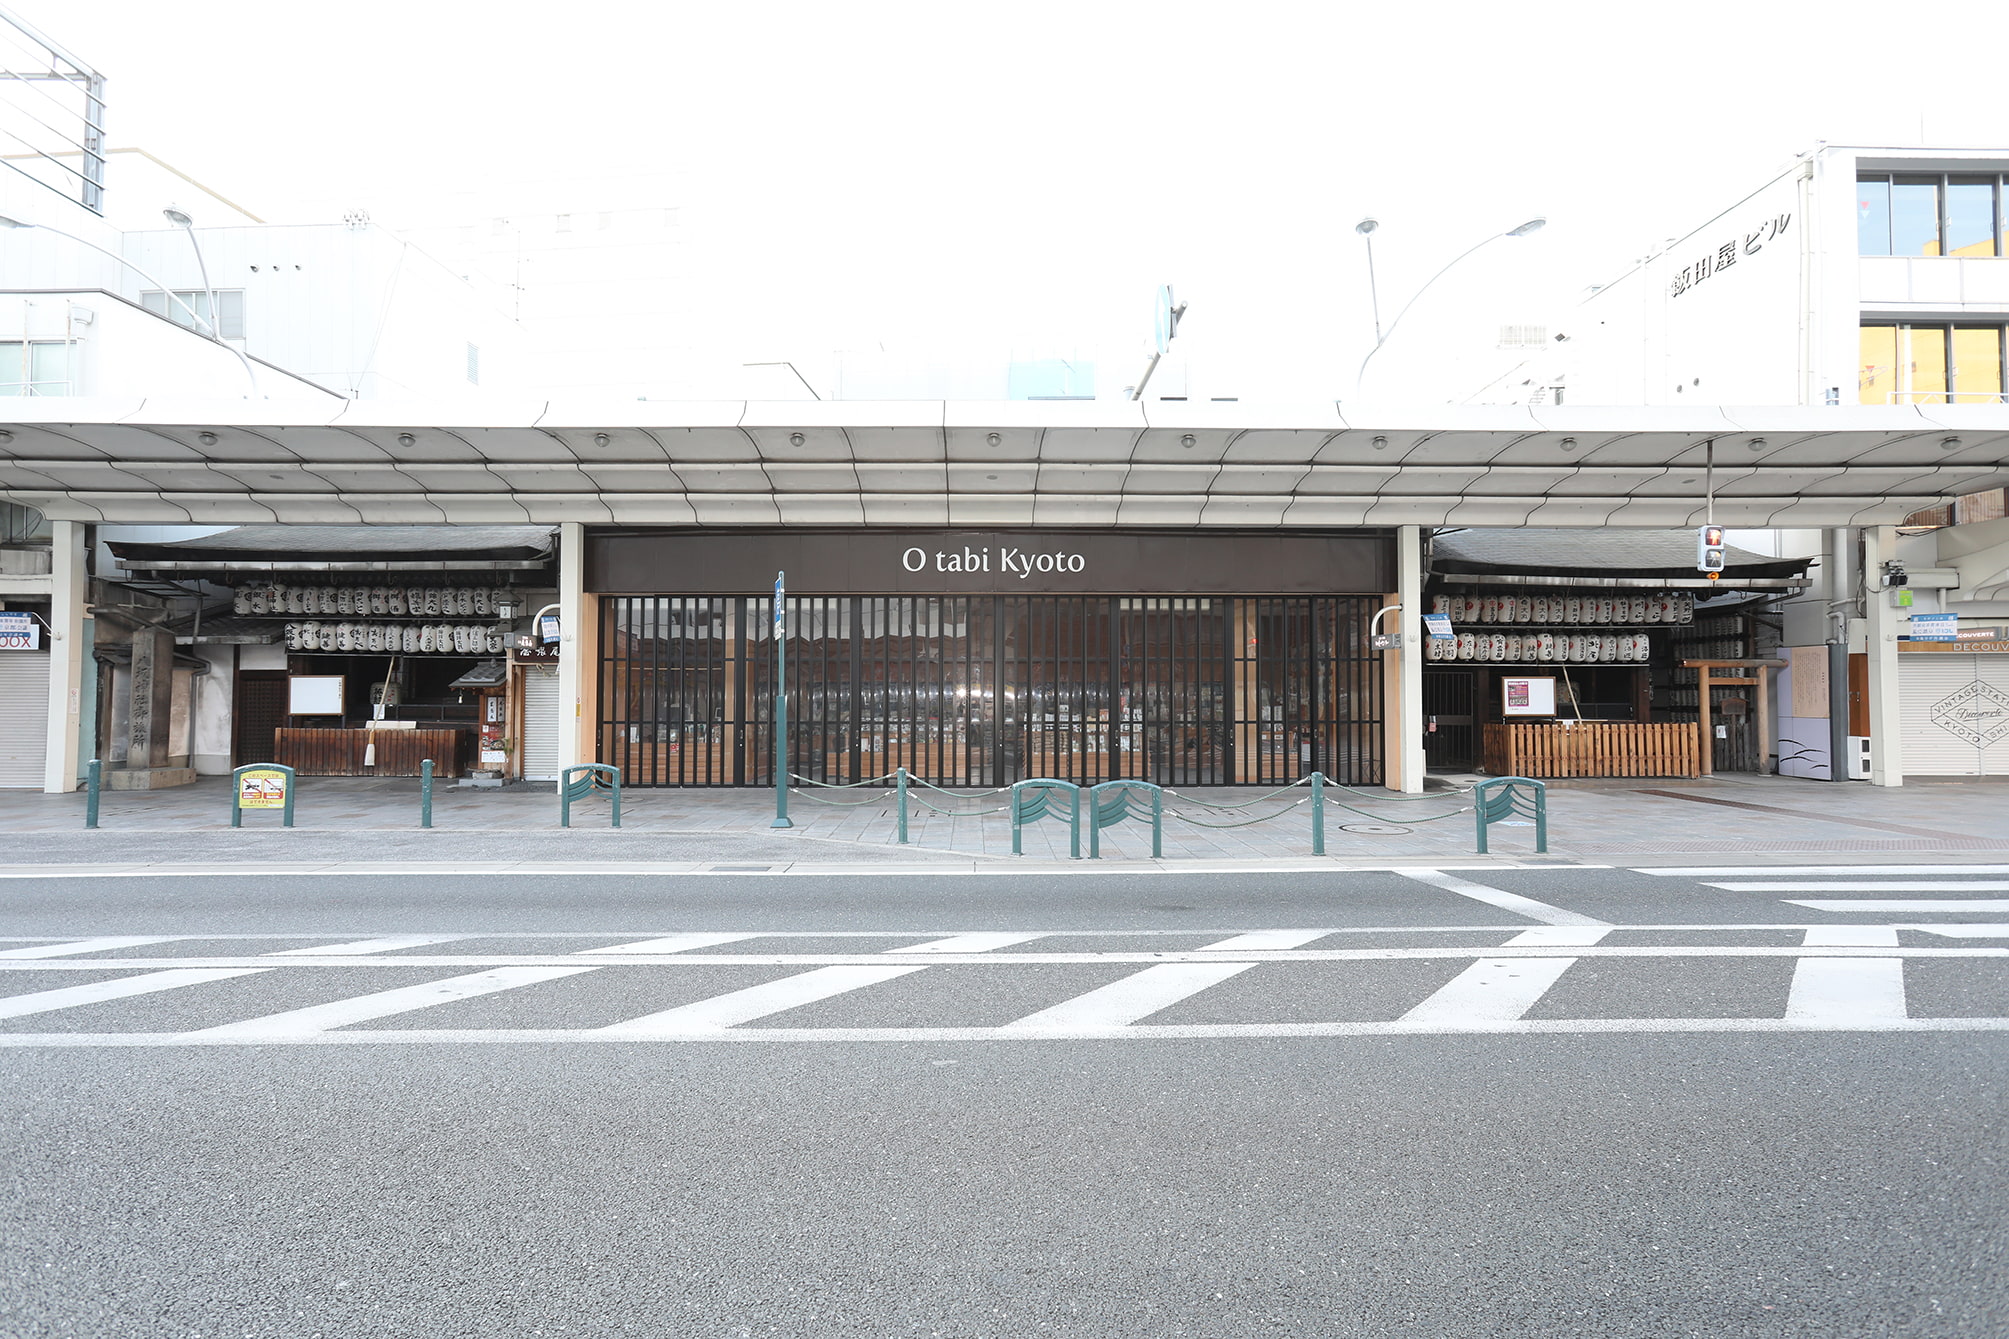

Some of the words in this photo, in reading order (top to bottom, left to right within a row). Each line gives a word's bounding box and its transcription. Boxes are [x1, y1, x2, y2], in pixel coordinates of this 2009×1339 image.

[1671, 213, 1792, 298] 飯田屋ビル
[902, 547, 927, 572] O
[936, 546, 990, 572] tabi
[1001, 547, 1085, 579] Kyoto
[1934, 685, 1978, 713] VINTAGE
[1944, 720, 1980, 743] KYOTO
